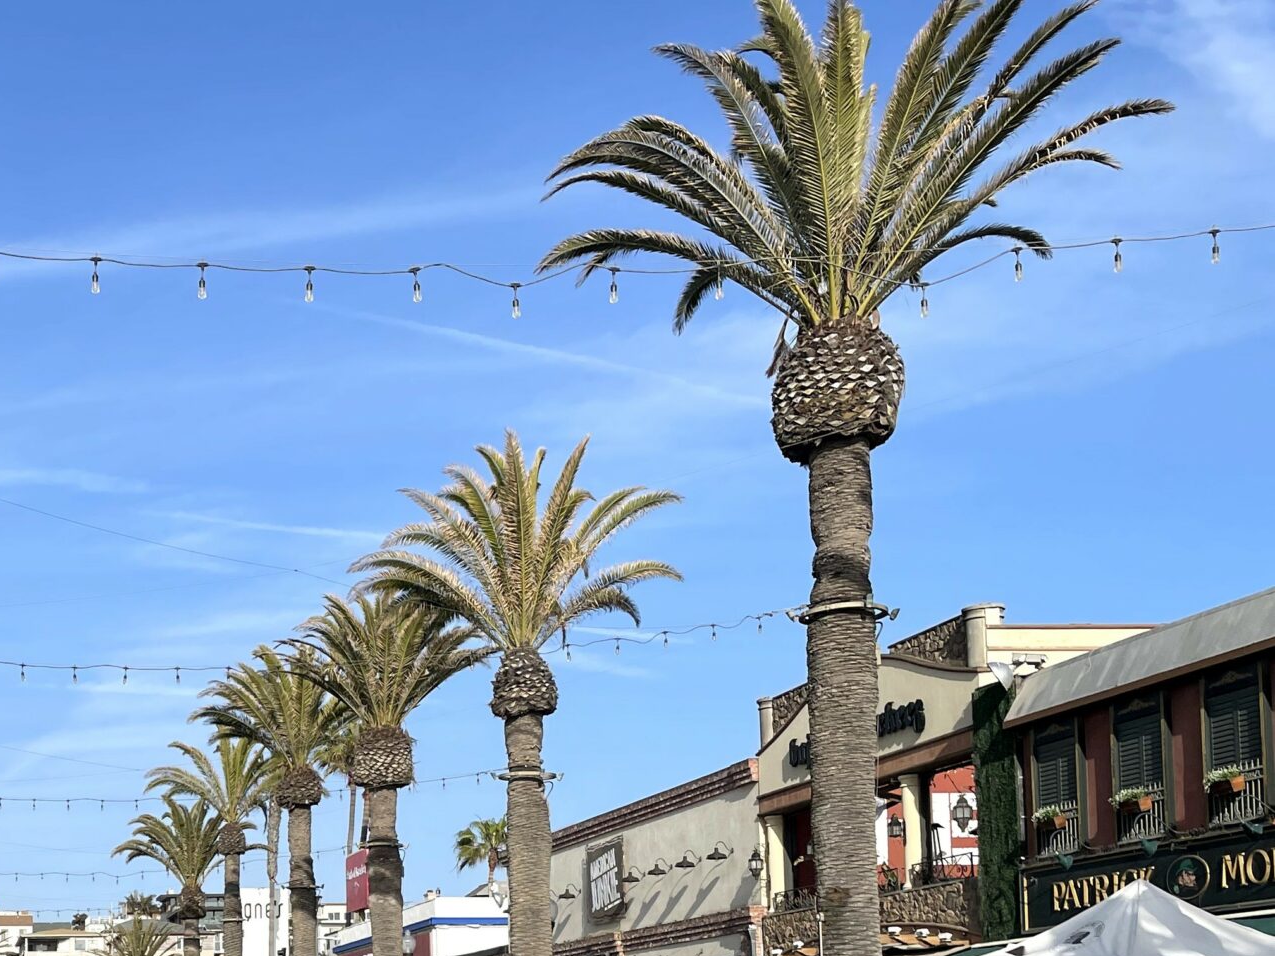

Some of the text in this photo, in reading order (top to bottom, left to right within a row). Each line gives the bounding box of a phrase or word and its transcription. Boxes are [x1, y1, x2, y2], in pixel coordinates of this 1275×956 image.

[590, 848, 617, 882] AMERICAN
[1222, 848, 1275, 889] MO
[591, 867, 621, 913] JUNKIE
